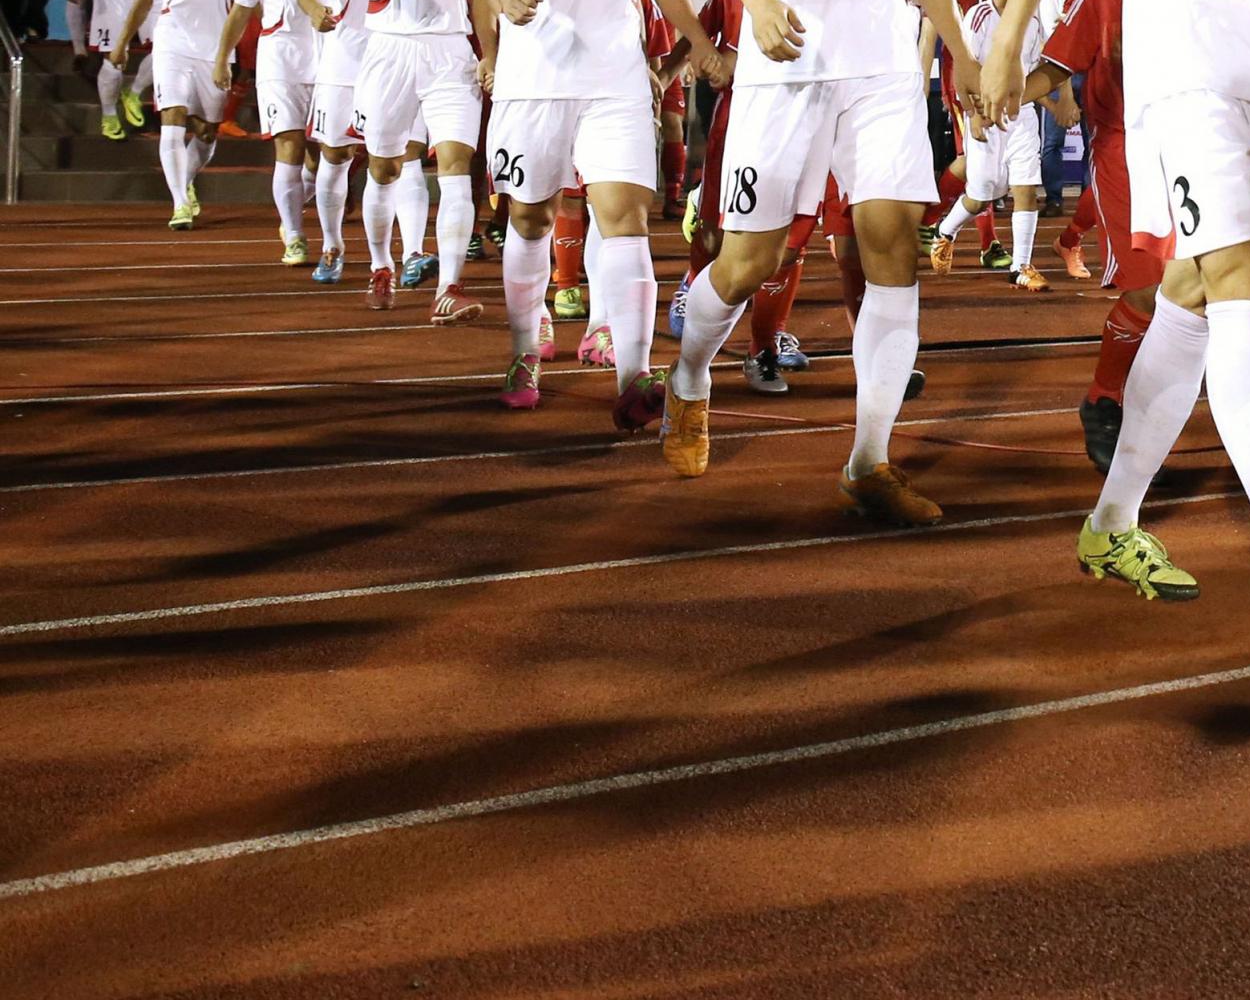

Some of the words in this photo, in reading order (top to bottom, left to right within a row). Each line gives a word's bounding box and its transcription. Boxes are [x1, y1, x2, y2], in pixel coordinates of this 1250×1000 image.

[316, 109, 327, 134] 11
[494, 148, 525, 187] 26
[727, 166, 758, 215] 18
[1173, 175, 1201, 237] 3
